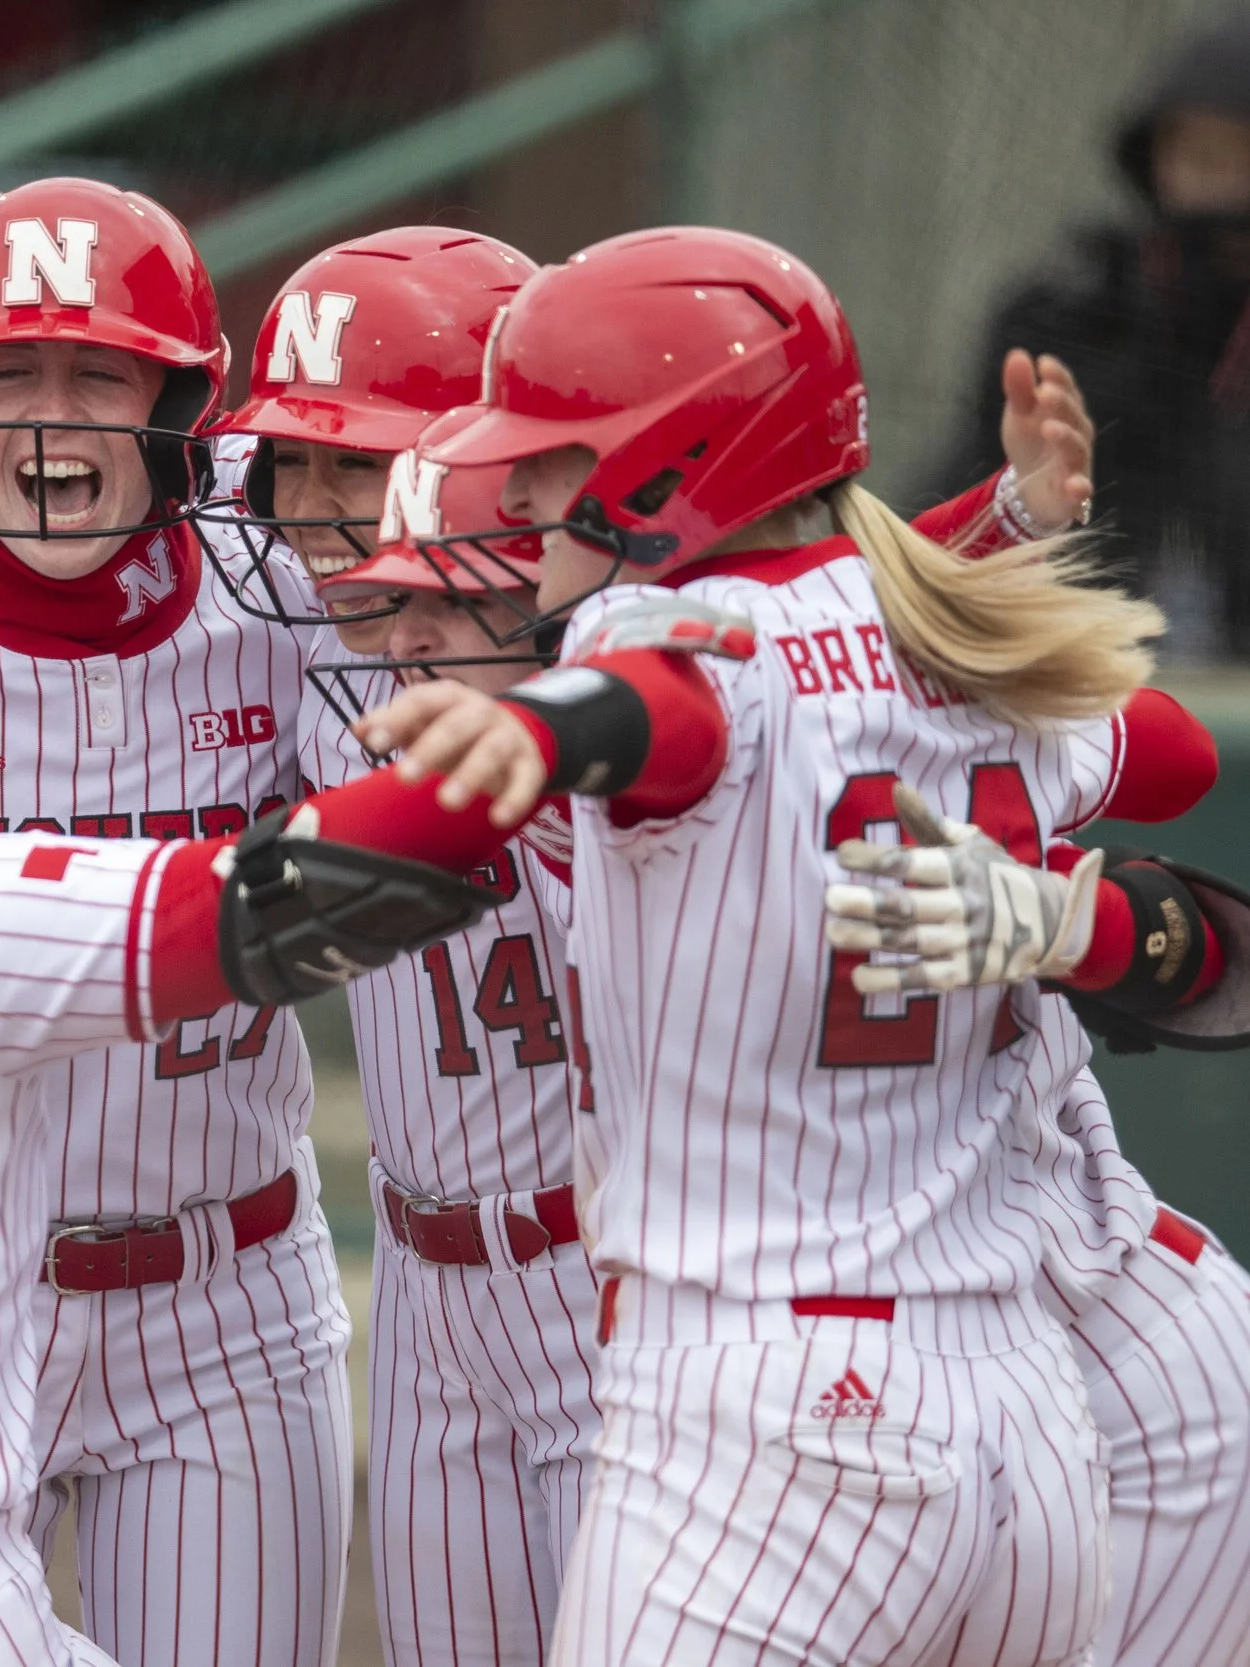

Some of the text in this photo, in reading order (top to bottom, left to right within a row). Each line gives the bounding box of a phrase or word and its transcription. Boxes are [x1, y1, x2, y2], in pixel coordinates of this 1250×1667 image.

[0, 216, 98, 308] N
[266, 290, 357, 386] N
[377, 448, 450, 544] N
[114, 529, 178, 626] N
[774, 624, 946, 708] BRE
[421, 933, 569, 1078] 14
